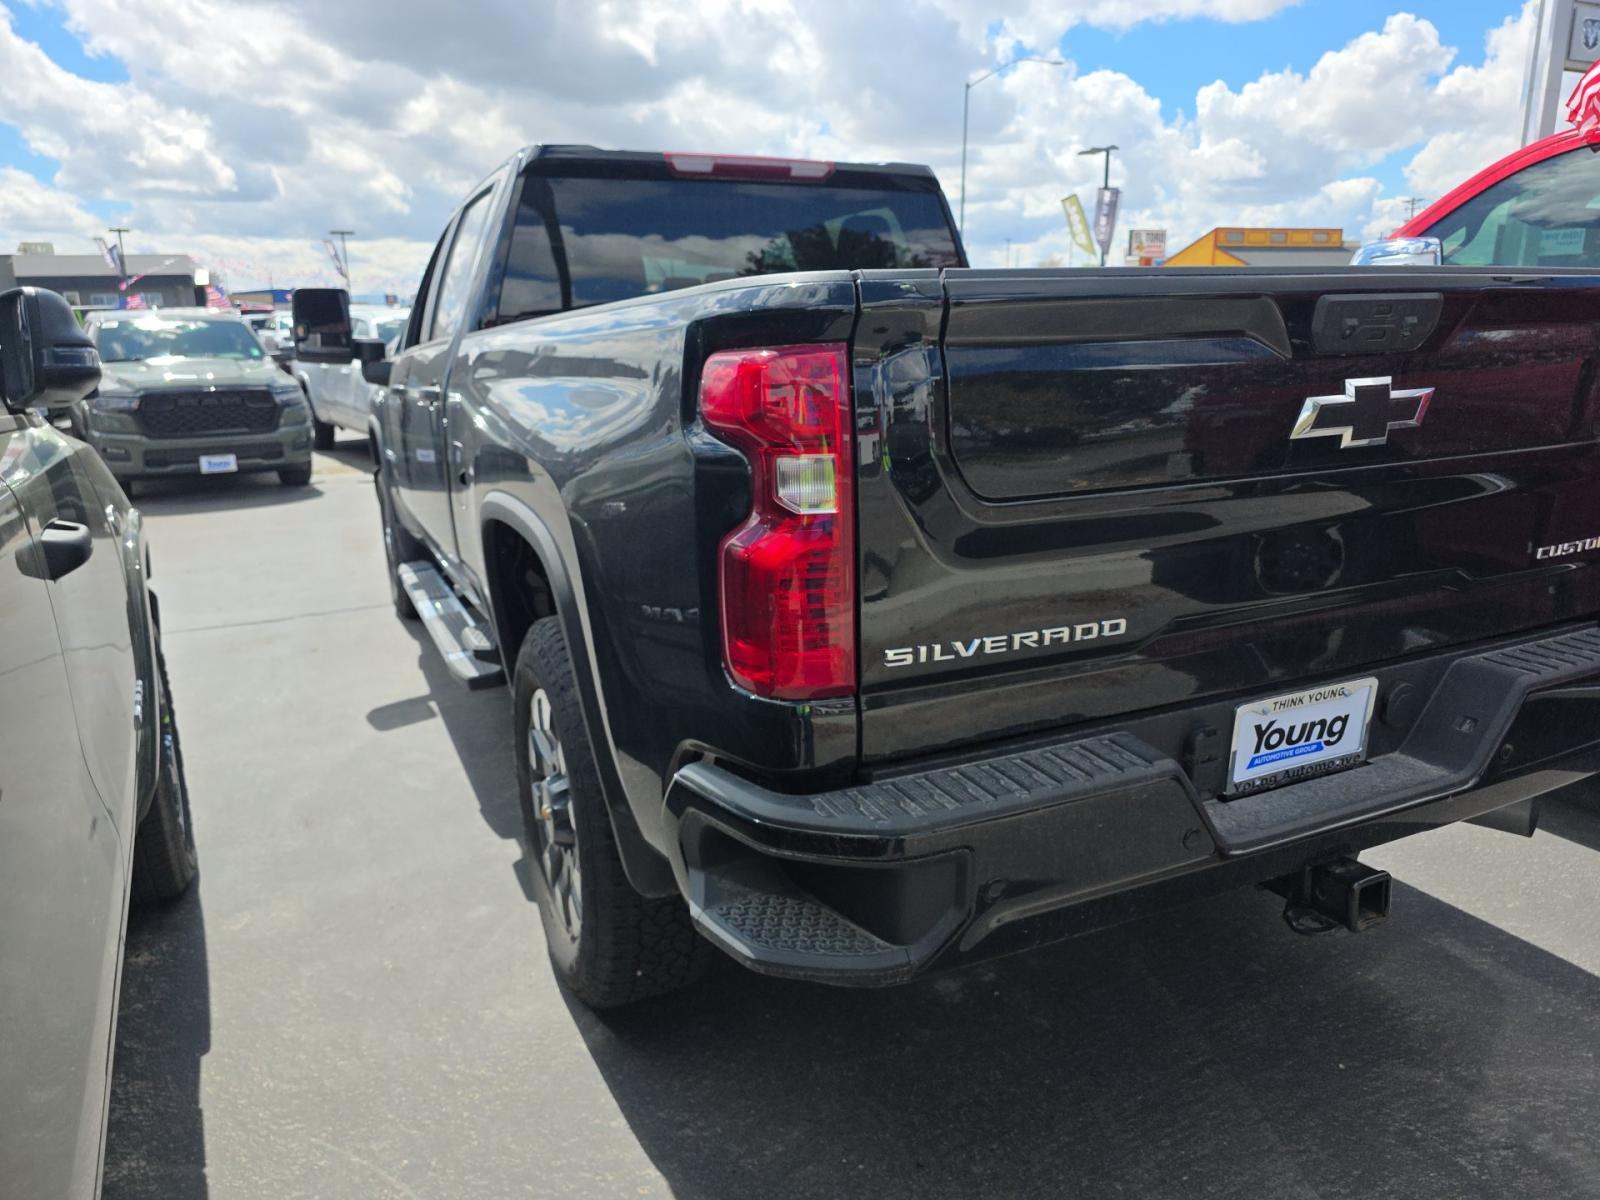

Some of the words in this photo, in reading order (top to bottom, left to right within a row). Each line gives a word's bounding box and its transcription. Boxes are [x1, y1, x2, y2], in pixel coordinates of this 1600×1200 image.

[1536, 536, 1600, 559] CUSTO
[884, 618, 1127, 667] SILVERADO
[1273, 696, 1304, 711] THINK
[1308, 687, 1346, 704] YOUNG
[1253, 714, 1350, 755] Young
[1253, 750, 1294, 766] AUTOMOTIVE
[1294, 743, 1318, 756] GROUP
[1282, 753, 1361, 778] Automoive
